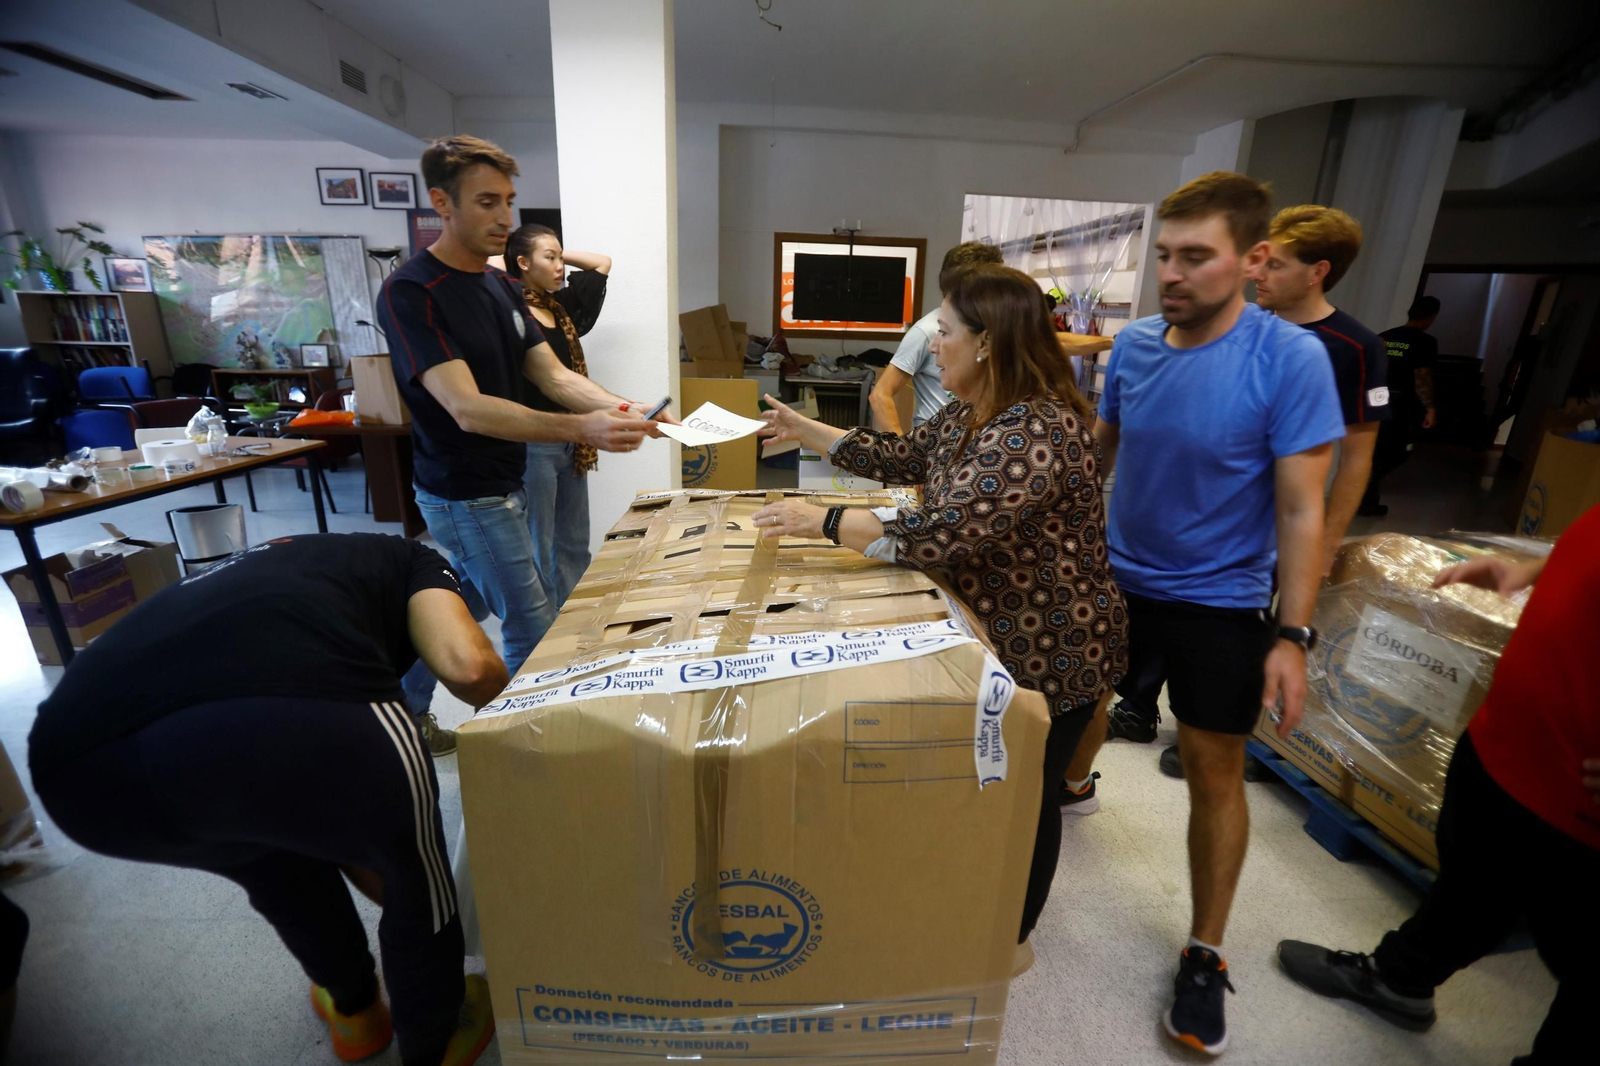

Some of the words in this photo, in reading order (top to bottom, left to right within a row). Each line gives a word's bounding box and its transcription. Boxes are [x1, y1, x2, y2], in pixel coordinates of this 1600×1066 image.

[416, 216, 443, 227] BOMB
[836, 640, 886, 652] Smurfit
[724, 653, 775, 669] Smurfit
[837, 648, 880, 662] Kappa
[1363, 626, 1459, 684] CÓRDOBA
[571, 659, 607, 673] Kappa
[725, 665, 767, 679] Kappa
[614, 667, 664, 681] Smurfit
[612, 678, 655, 691] Kappa
[514, 690, 559, 702] Smurfit
[508, 698, 546, 710] Kappa
[977, 719, 991, 758] Kappa
[719, 868, 742, 882] DE
[748, 869, 824, 922] ALIMENTOS
[719, 904, 790, 918] ESBAL
[722, 972, 744, 983] DE
[750, 935, 823, 983] ALIMENTOS
[534, 984, 612, 1001] Donación
[617, 994, 733, 1009] recomendada
[533, 1005, 706, 1033] CONSERVAS
[731, 1016, 835, 1034] ACEITE
[861, 1013, 954, 1032] LECHE
[572, 1032, 646, 1047] (PESCADO
[651, 1039, 659, 1048] Y
[664, 1040, 750, 1052] VERDURAS)
